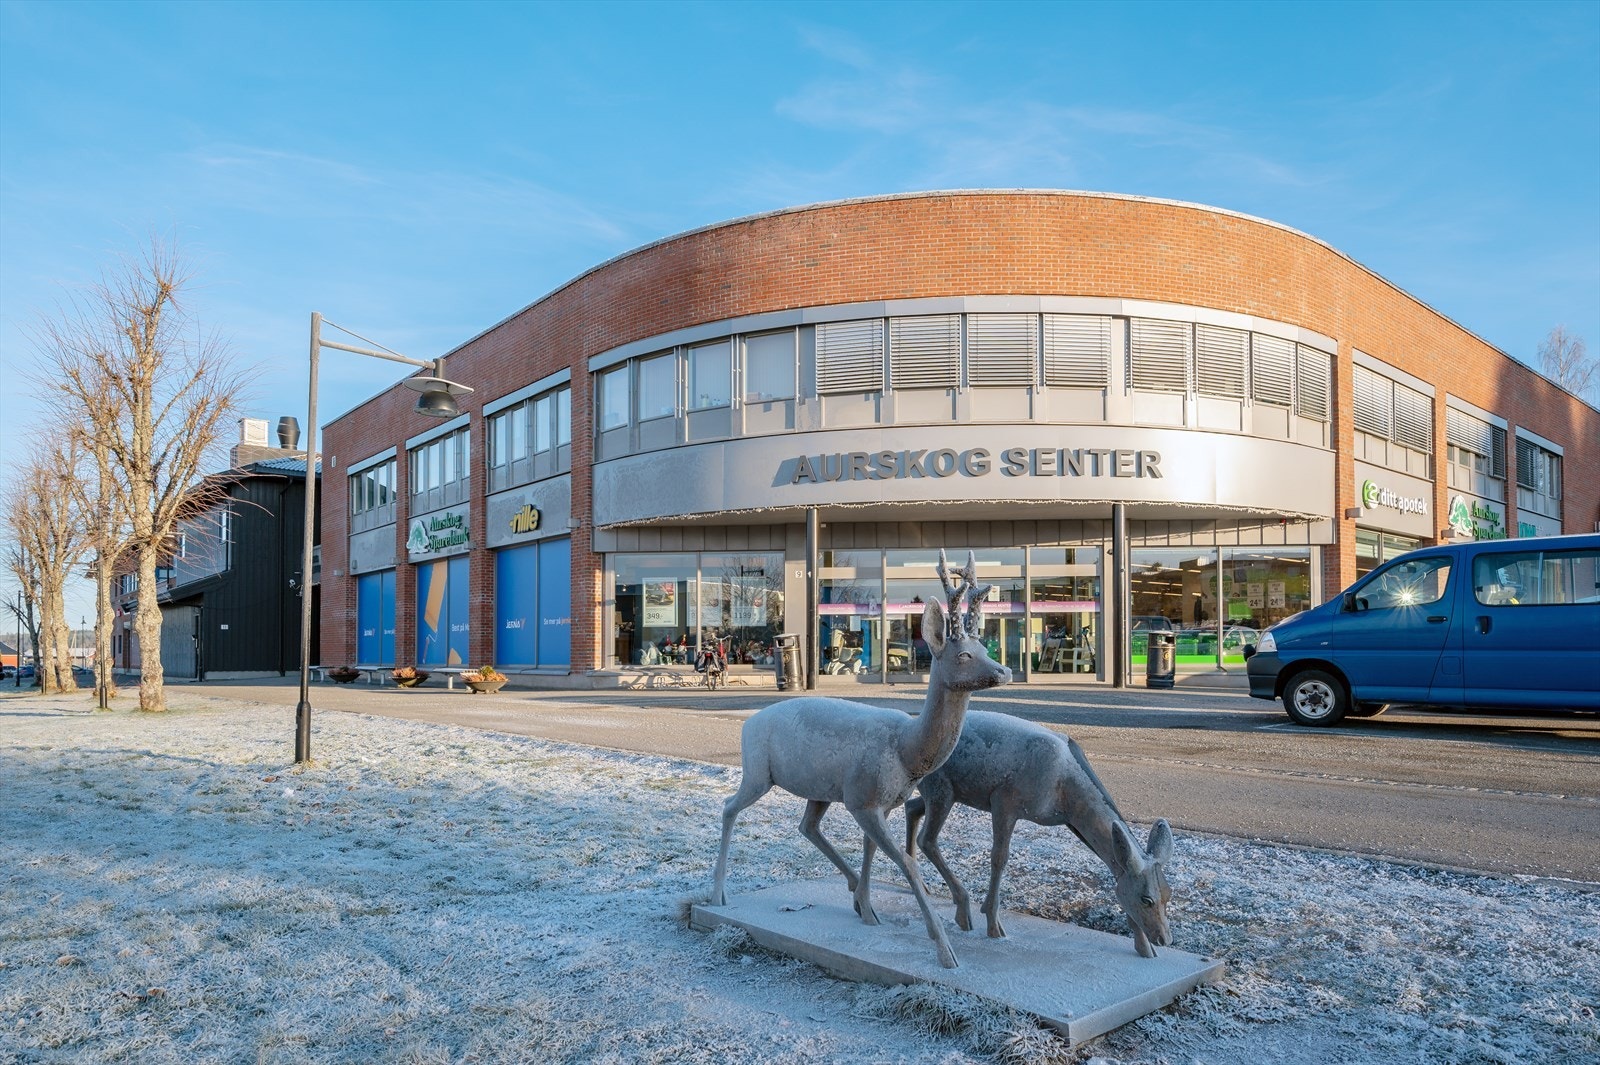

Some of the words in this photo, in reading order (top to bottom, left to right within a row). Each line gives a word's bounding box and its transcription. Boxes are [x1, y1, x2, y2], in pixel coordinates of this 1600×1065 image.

[791, 447, 992, 484] AURSKOG
[1000, 446, 1163, 479] SENTER
[1380, 487, 1398, 508] ditt
[1398, 496, 1428, 515] apotek
[429, 512, 463, 532] Aurskog
[511, 503, 540, 534] nille
[429, 526, 470, 552] Sparebank
[796, 570, 802, 578] 9
[1249, 599, 1259, 607] 24
[1270, 598, 1279, 606] 24
